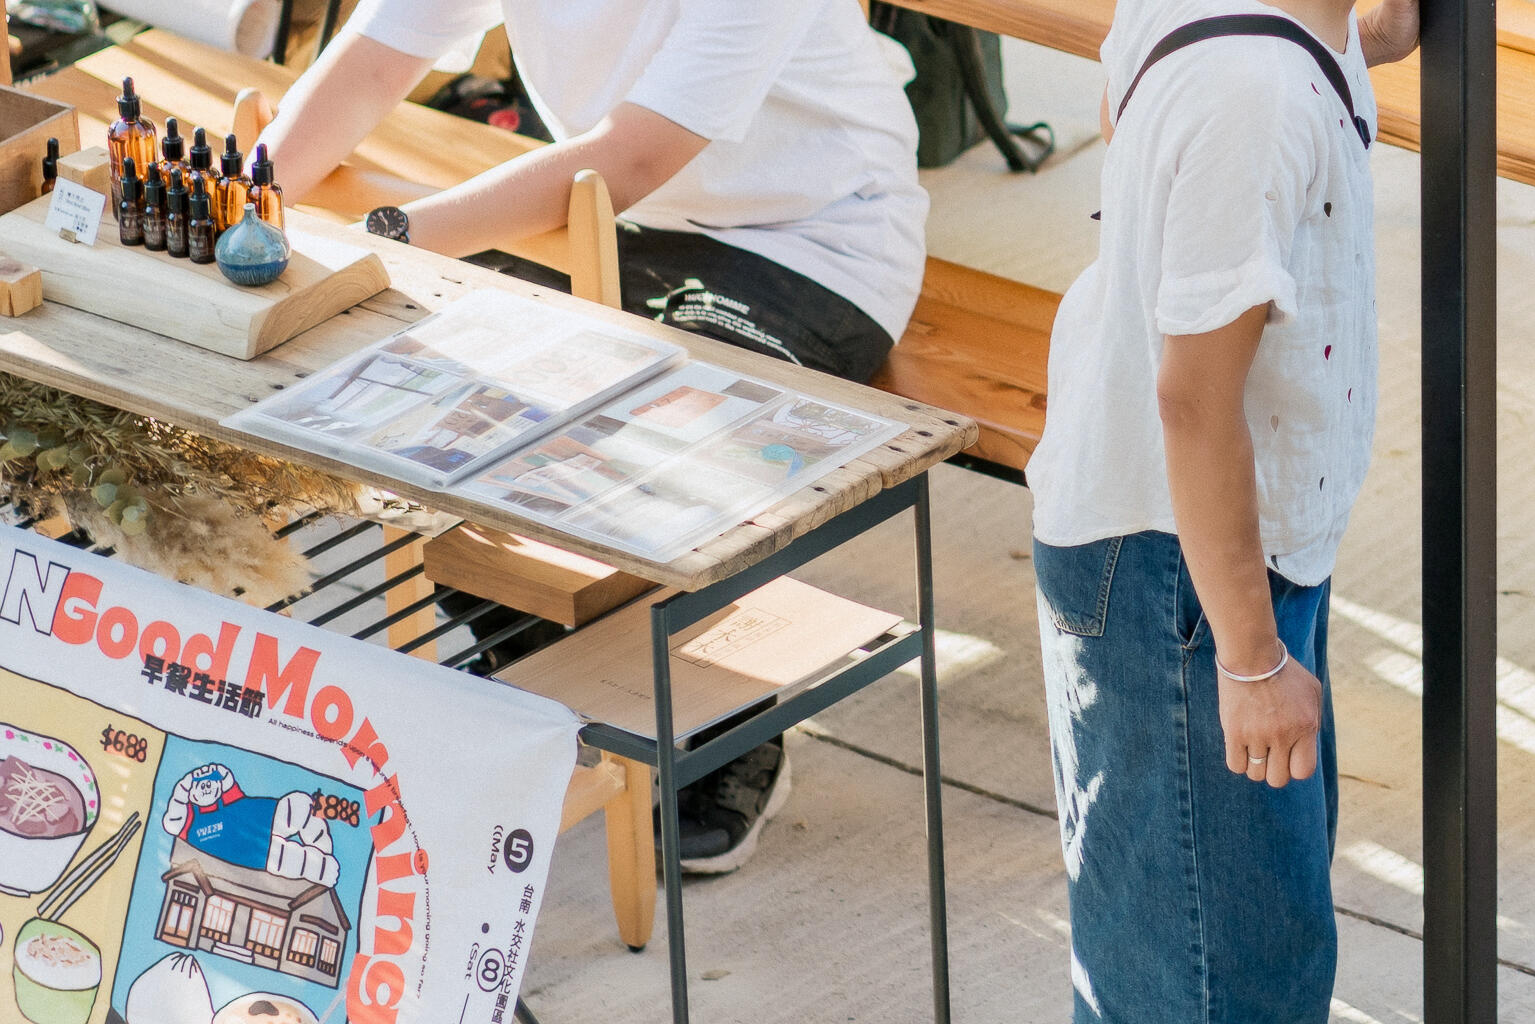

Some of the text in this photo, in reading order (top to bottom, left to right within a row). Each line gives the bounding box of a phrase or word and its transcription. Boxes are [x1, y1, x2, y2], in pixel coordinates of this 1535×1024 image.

[141, 653, 266, 719] 早餐生活節
[100, 724, 148, 763] $688
[279, 721, 315, 739] happiness
[51, 571, 243, 690] Good
[240, 631, 429, 1024] Morning
[311, 788, 361, 828] $888
[518, 883, 535, 915] 台南
